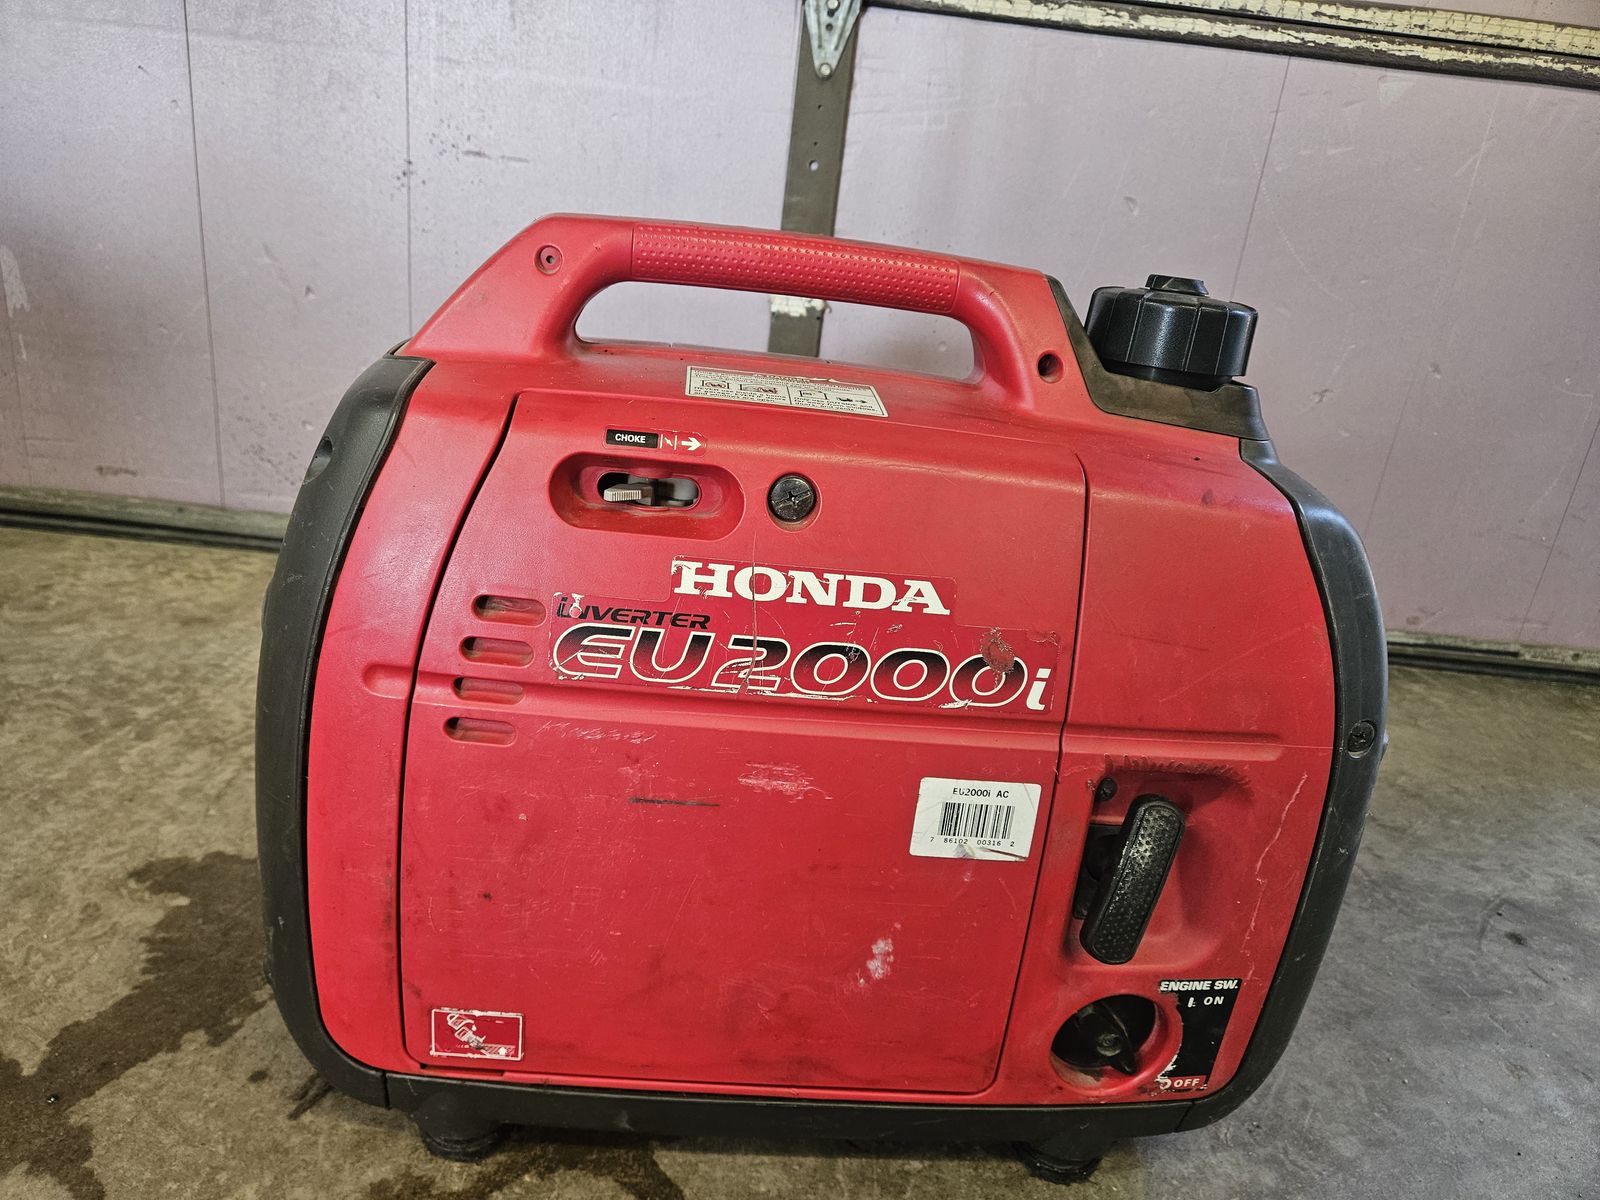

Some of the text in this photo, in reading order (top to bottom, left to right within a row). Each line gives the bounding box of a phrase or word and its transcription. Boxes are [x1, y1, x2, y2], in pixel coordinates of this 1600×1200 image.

[614, 433, 646, 444] CHOKE
[673, 559, 951, 616] HONDA
[552, 621, 1053, 712] EU2000i
[952, 787, 1010, 799] EU2000i AC
[943, 837, 969, 845] 86102
[976, 839, 1002, 847] 00316
[1159, 979, 1239, 992] ENGINE SW.
[1203, 996, 1225, 1006] ON
[1173, 1078, 1201, 1088] OFF
